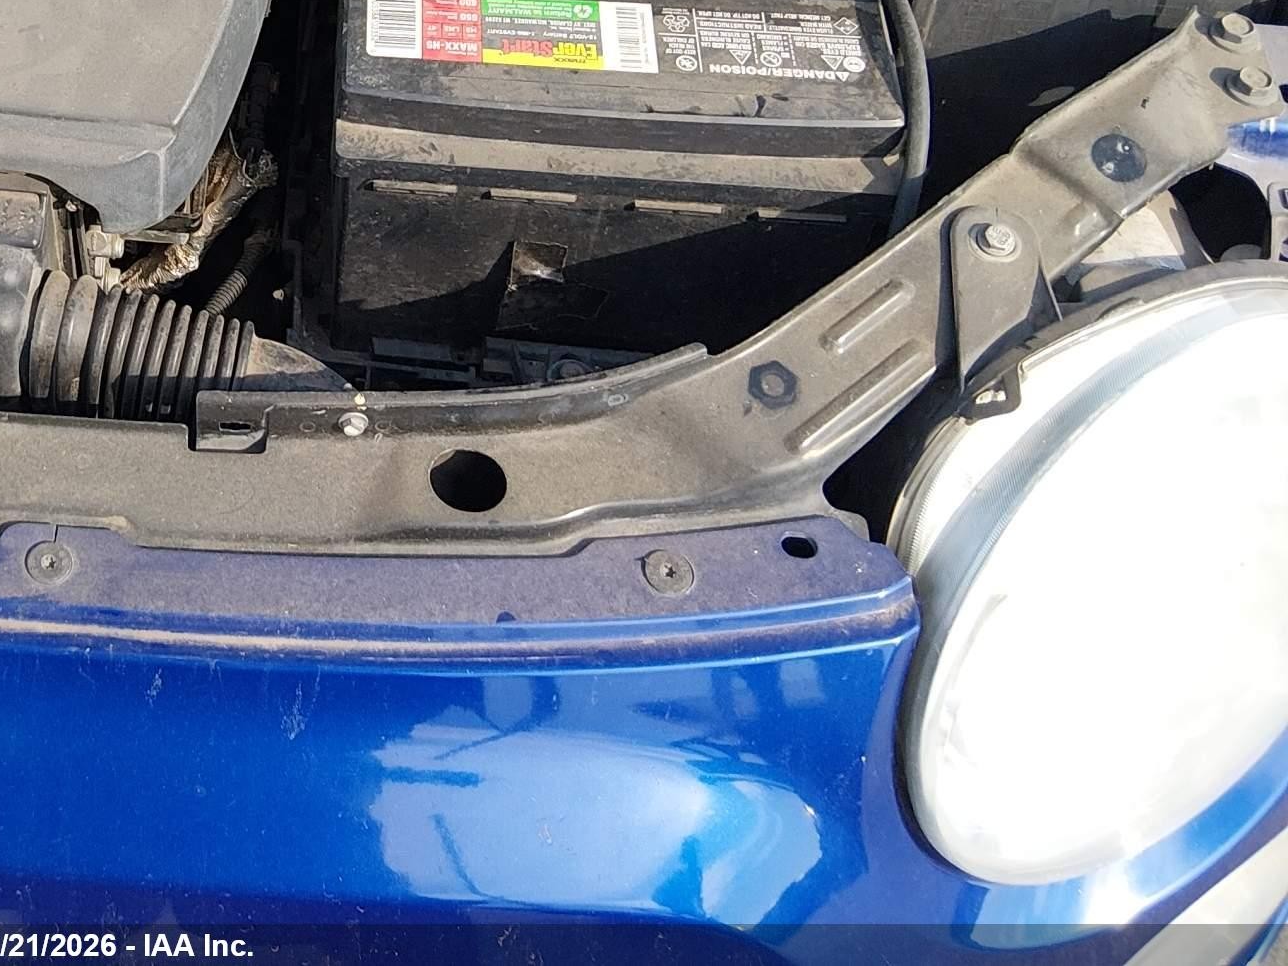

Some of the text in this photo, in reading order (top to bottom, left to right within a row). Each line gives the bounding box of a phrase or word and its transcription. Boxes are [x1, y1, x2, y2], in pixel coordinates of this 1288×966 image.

[426, 41, 478, 52] MAXX-H5
[502, 39, 598, 61] EverStart
[709, 64, 836, 80] DANGER/POISON
